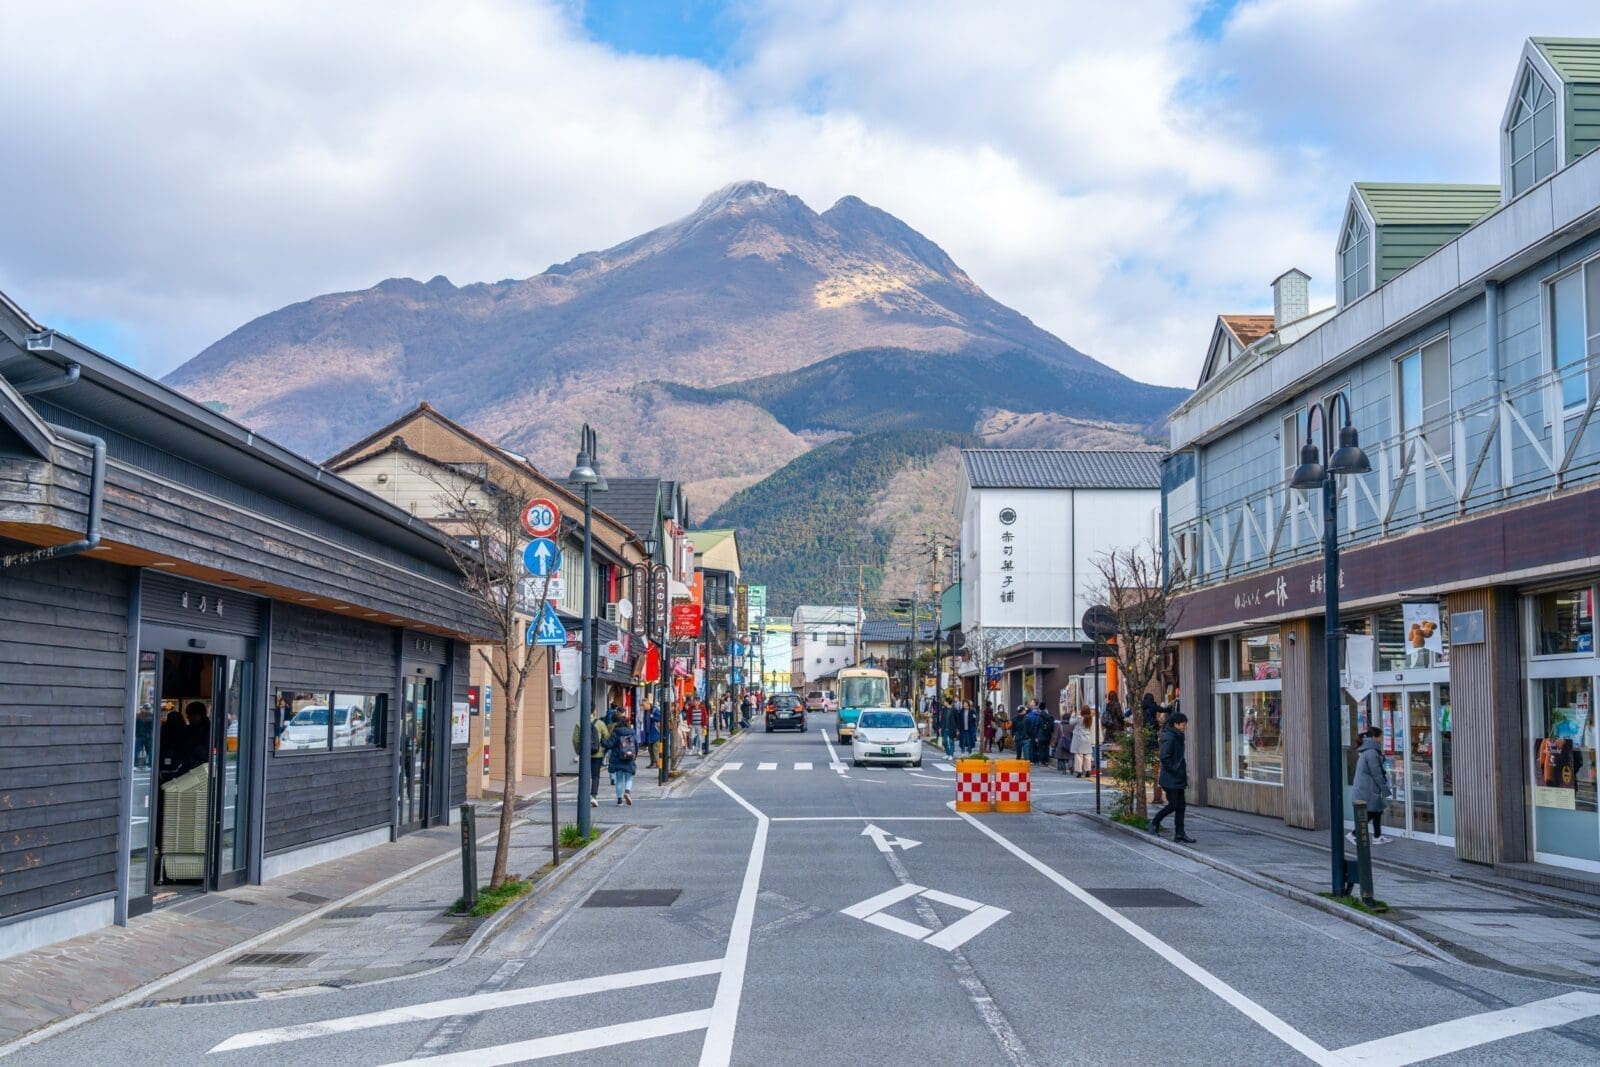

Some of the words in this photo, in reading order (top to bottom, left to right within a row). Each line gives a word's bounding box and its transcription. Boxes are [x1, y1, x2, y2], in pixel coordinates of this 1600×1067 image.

[531, 509, 552, 526] 30
[1000, 531, 1015, 603] 赤司菓子舗
[656, 572, 665, 621] バスのりば
